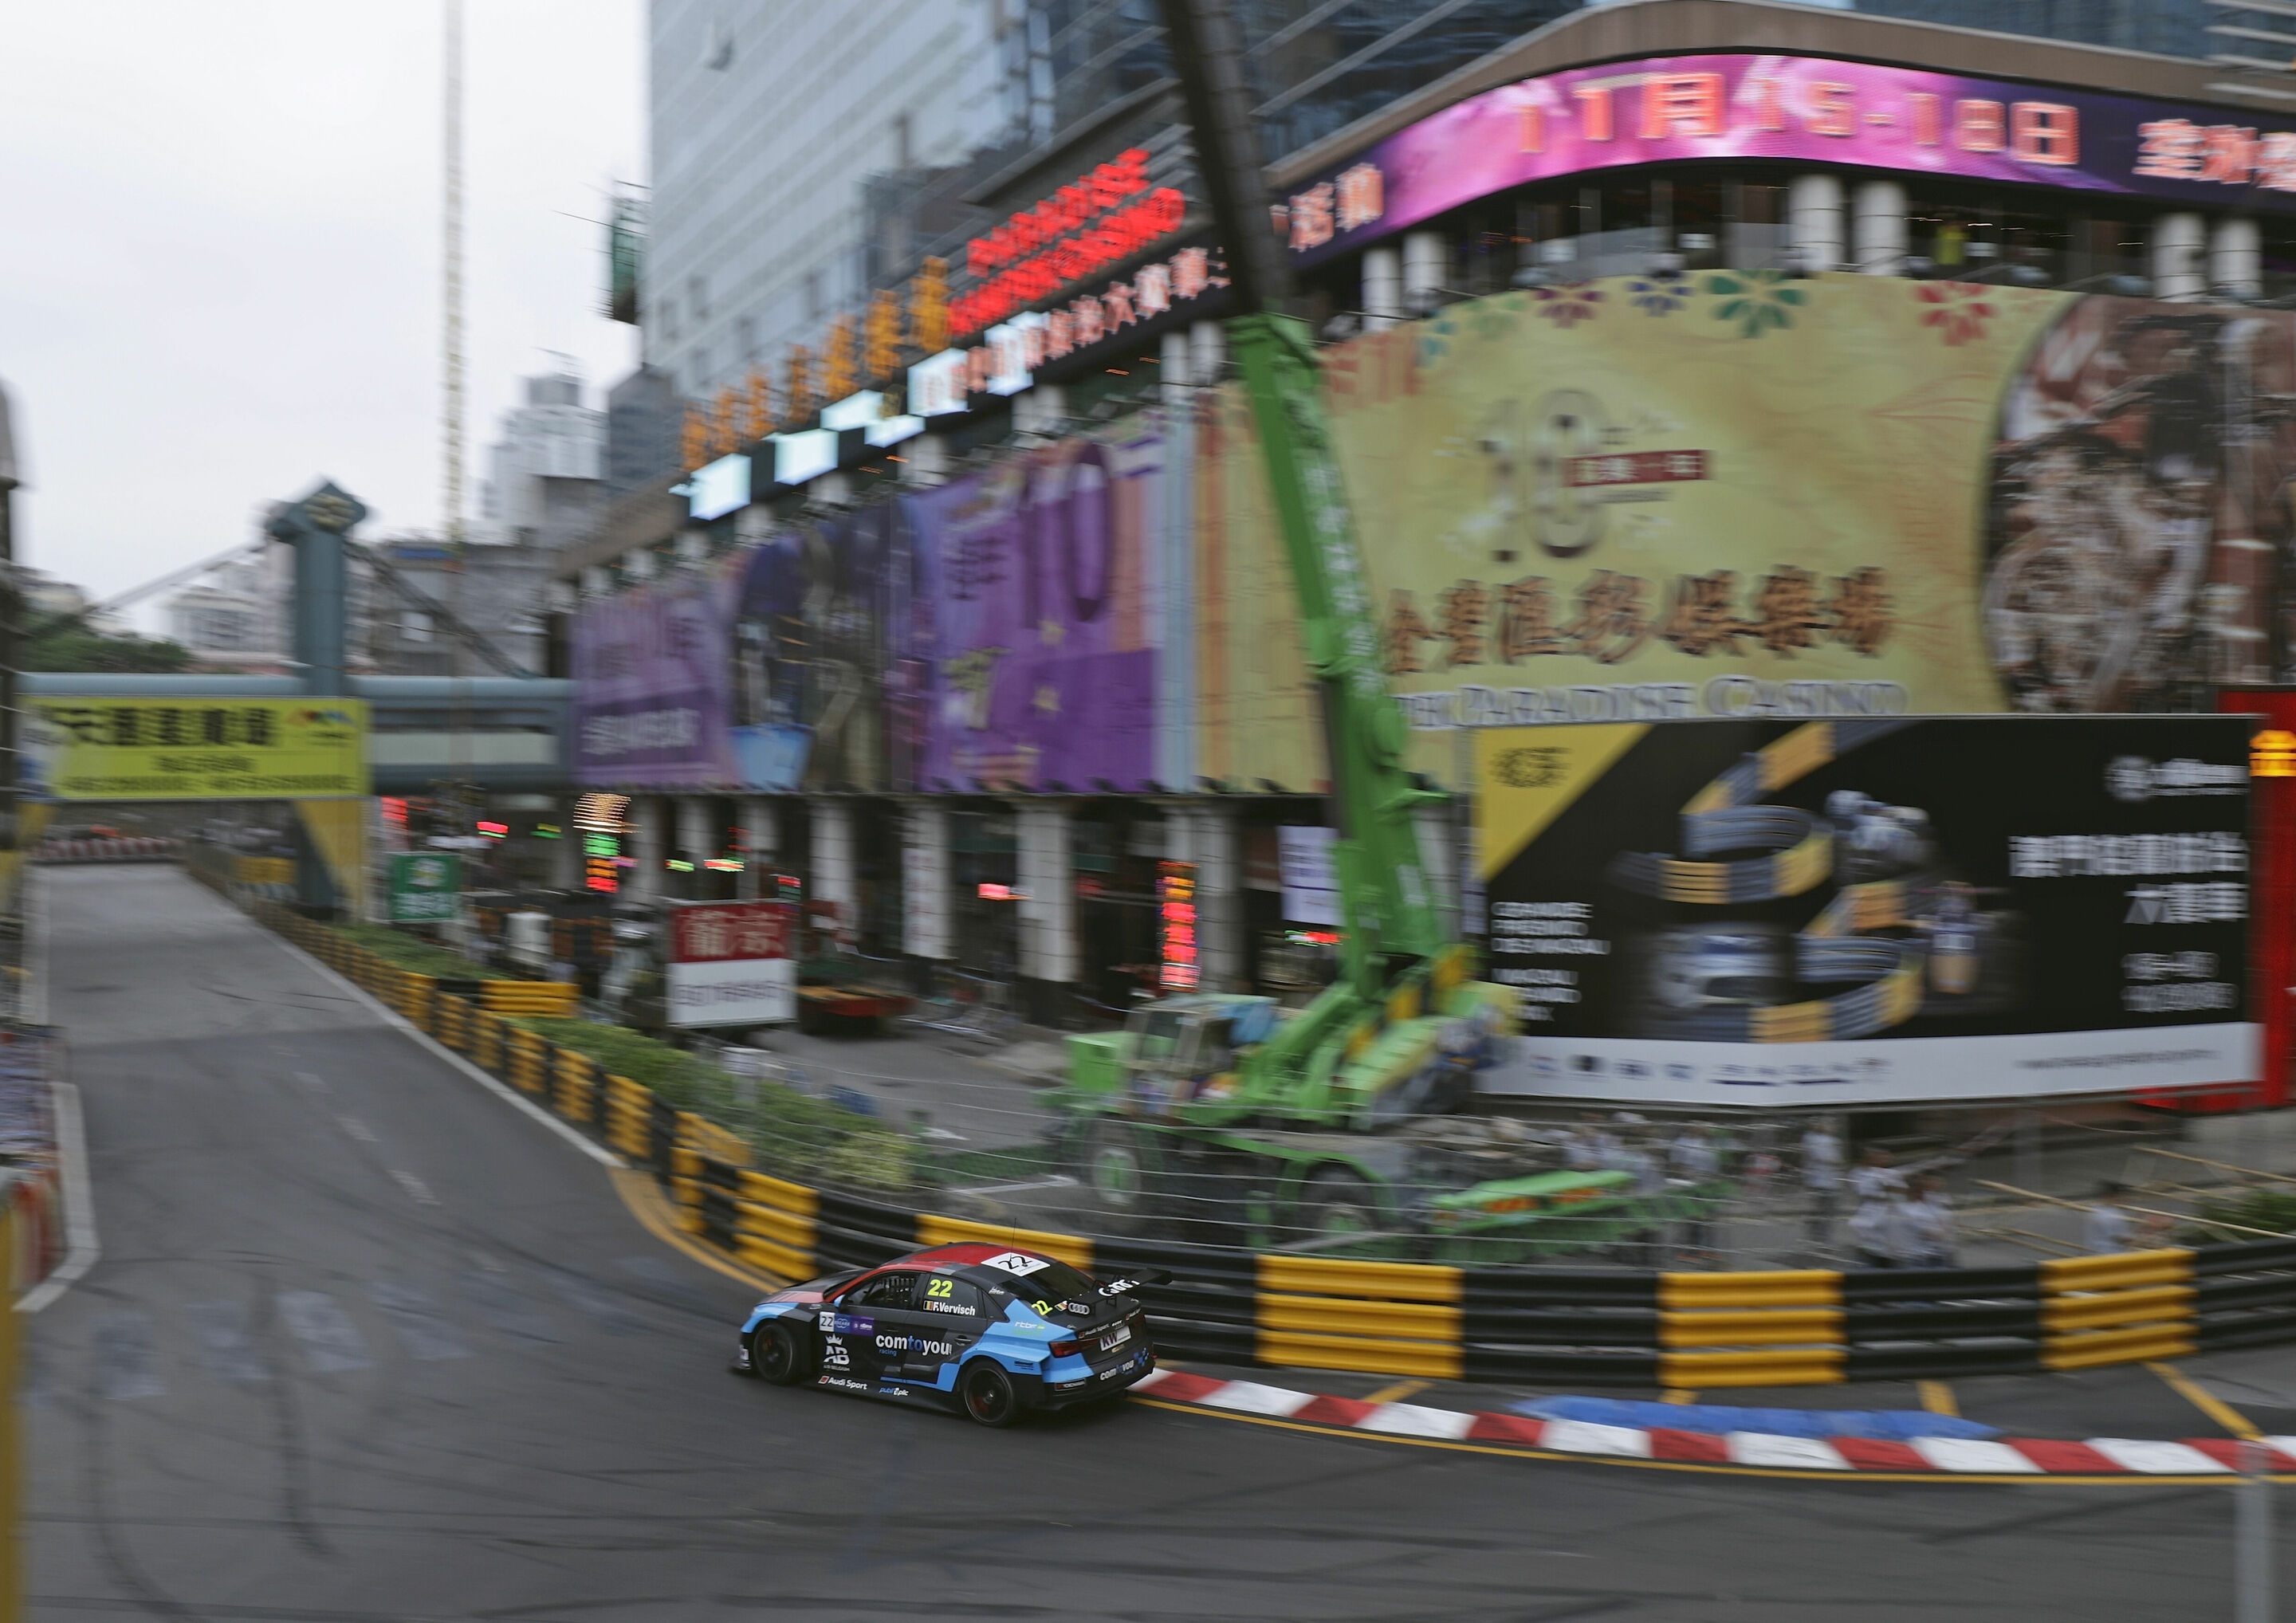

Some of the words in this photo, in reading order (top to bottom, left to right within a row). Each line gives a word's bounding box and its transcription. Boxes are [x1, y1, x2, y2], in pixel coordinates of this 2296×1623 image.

[1704, 674, 1907, 719] CASINO
[998, 1256, 1032, 1270] 22
[927, 1279, 953, 1298] 22
[933, 1302, 975, 1316] F.Vervisch
[1032, 1300, 1053, 1315] 22
[820, 1316, 833, 1327] 22
[1103, 1333, 1118, 1348] KW
[823, 1345, 851, 1366] AB
[828, 1377, 846, 1385] Audi
[846, 1380, 867, 1390] Sport
